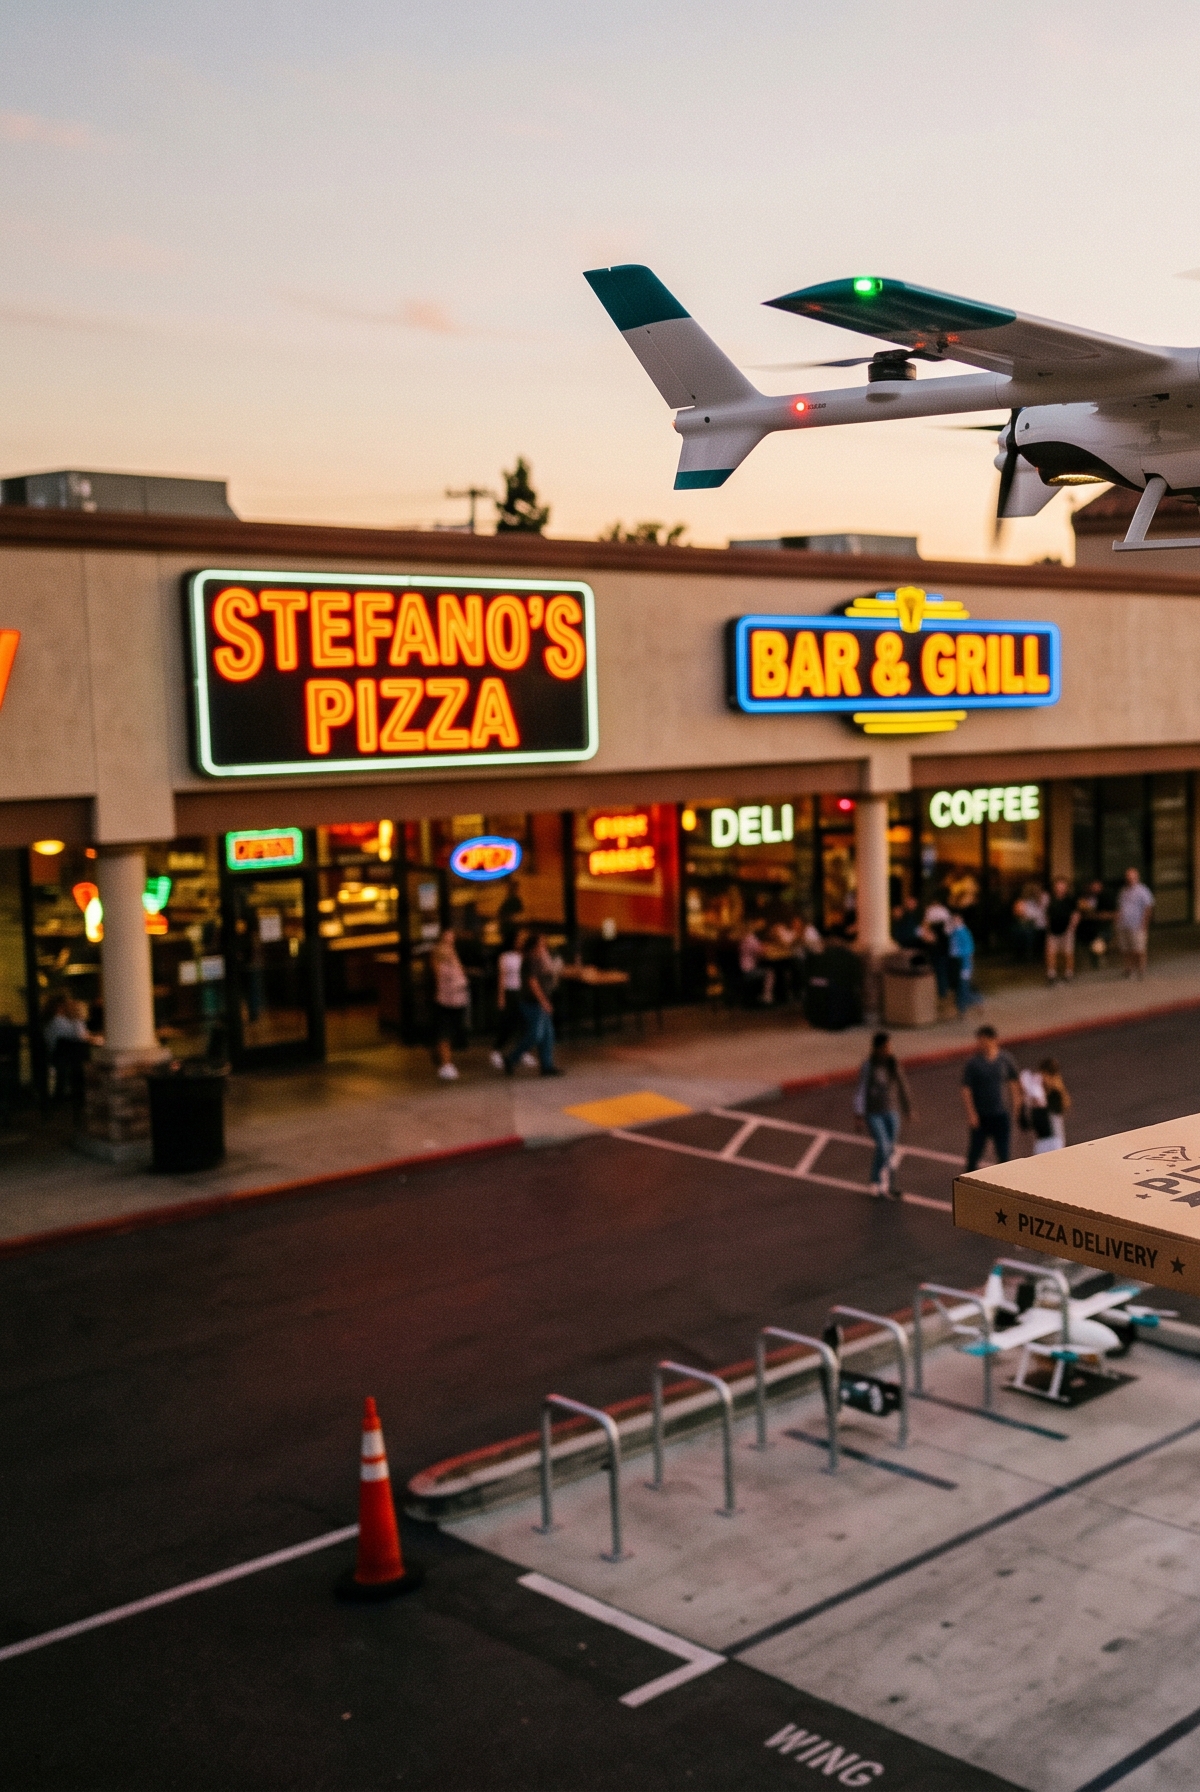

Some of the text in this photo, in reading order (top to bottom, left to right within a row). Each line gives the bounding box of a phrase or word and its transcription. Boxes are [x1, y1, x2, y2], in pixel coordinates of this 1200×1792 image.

[212, 586, 586, 682] STEFANO'S
[751, 630, 1050, 699] BAR & GRILL
[305, 677, 519, 755] PIZZA
[711, 803, 794, 848] DELI
[929, 785, 1040, 829] COFFEE
[1018, 1213, 1159, 1269] PIZZA DELIVERY
[764, 1722, 885, 1787] WING
